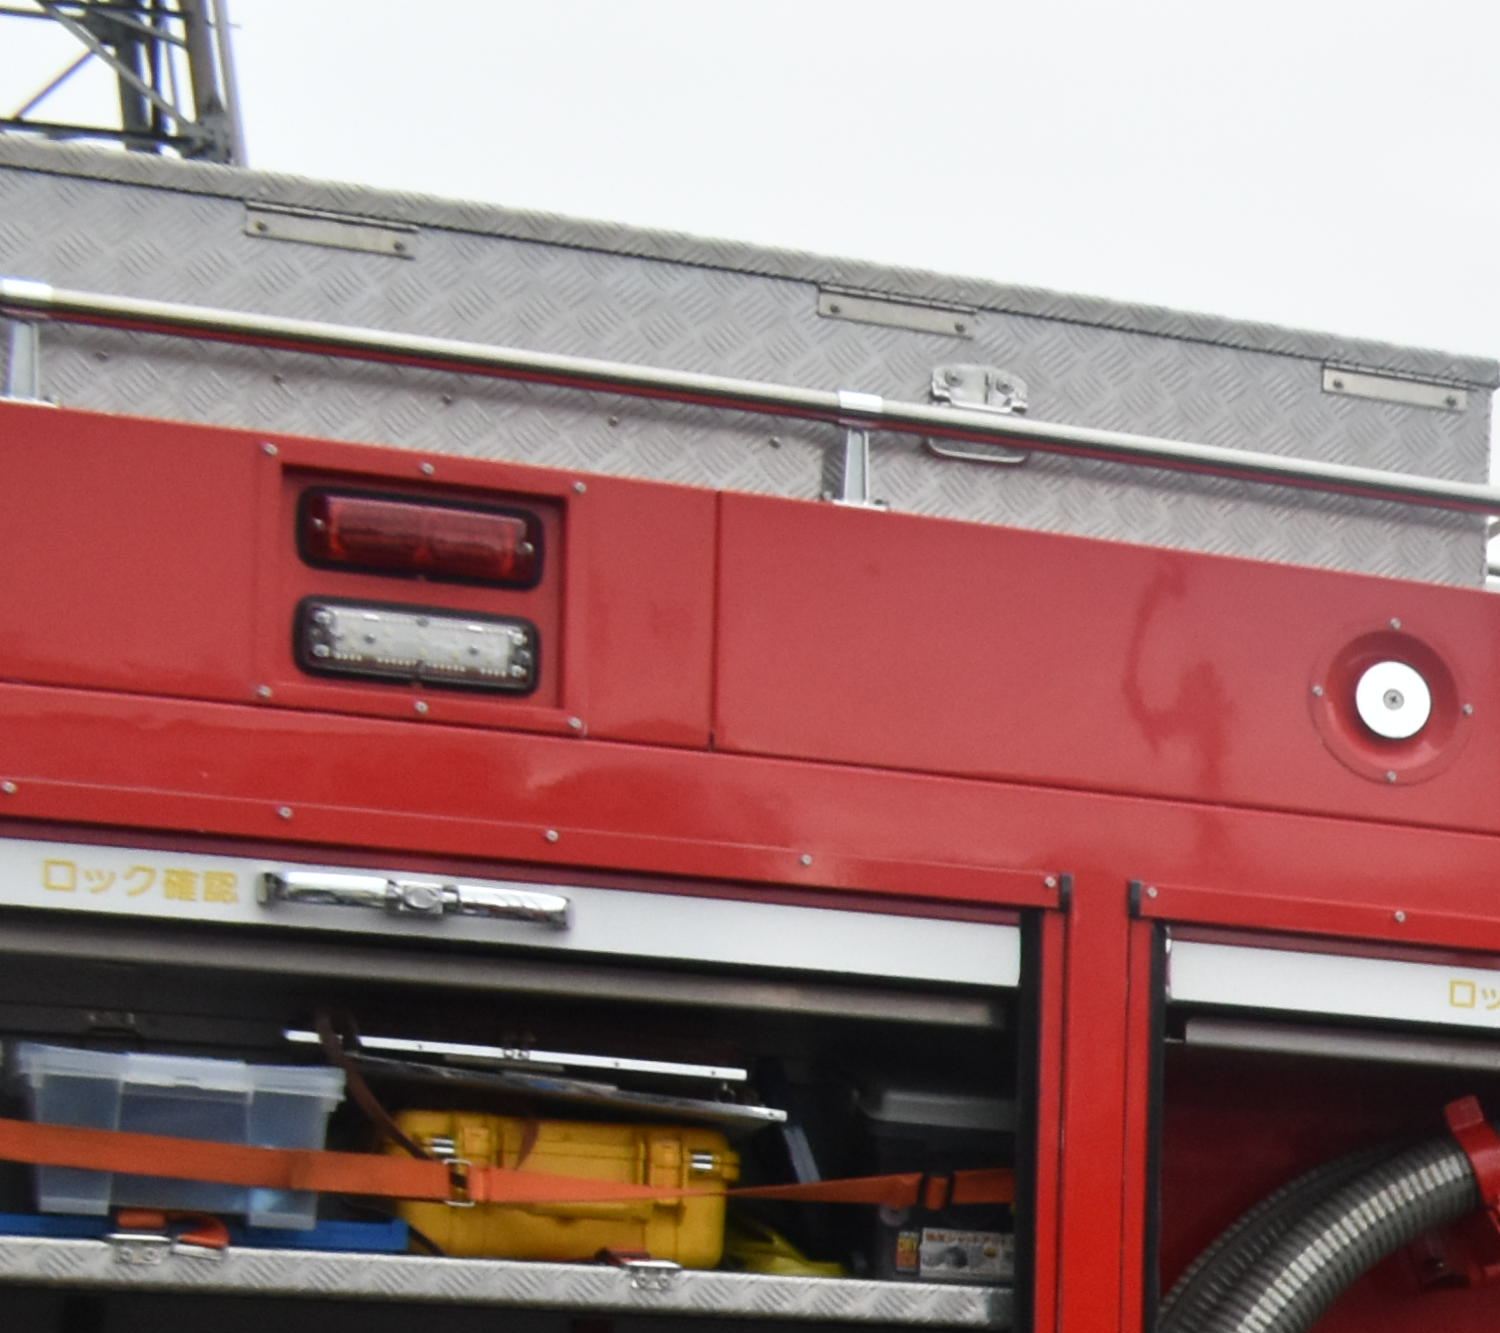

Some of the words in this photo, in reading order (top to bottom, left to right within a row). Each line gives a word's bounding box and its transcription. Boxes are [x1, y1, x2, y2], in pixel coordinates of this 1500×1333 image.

[42, 859, 240, 904] ロック確認
